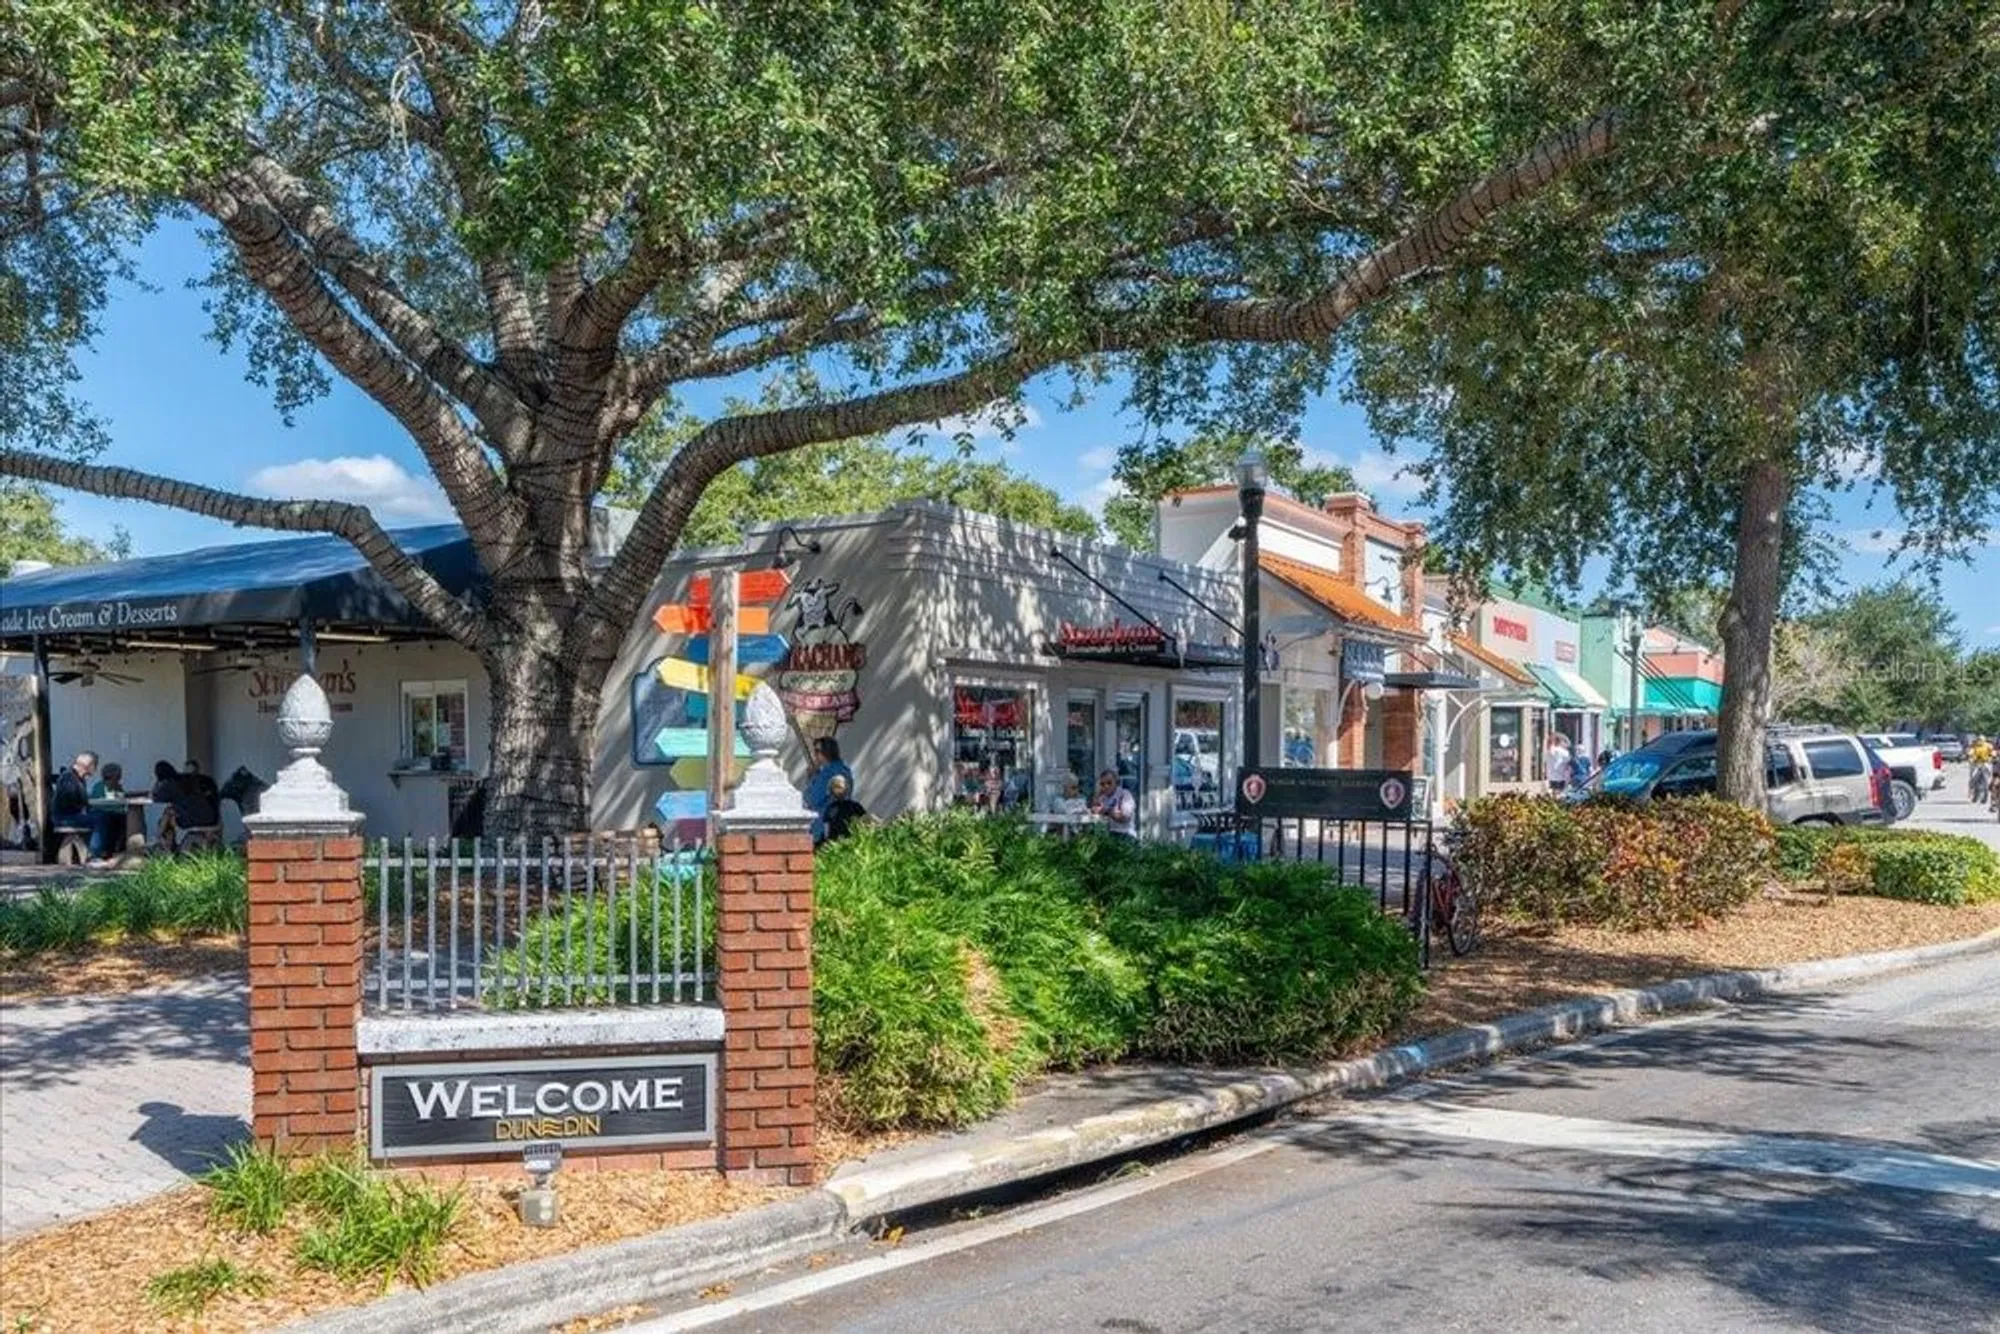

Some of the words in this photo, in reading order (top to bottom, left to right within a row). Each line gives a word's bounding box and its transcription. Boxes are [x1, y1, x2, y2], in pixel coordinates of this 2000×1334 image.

[27, 608, 46, 631] Ice
[49, 605, 95, 630] Cream
[98, 602, 113, 626] &
[117, 602, 178, 625] Desserts
[406, 1077, 684, 1120] WELCOME
[495, 1116, 601, 1140] DUNEDIN
